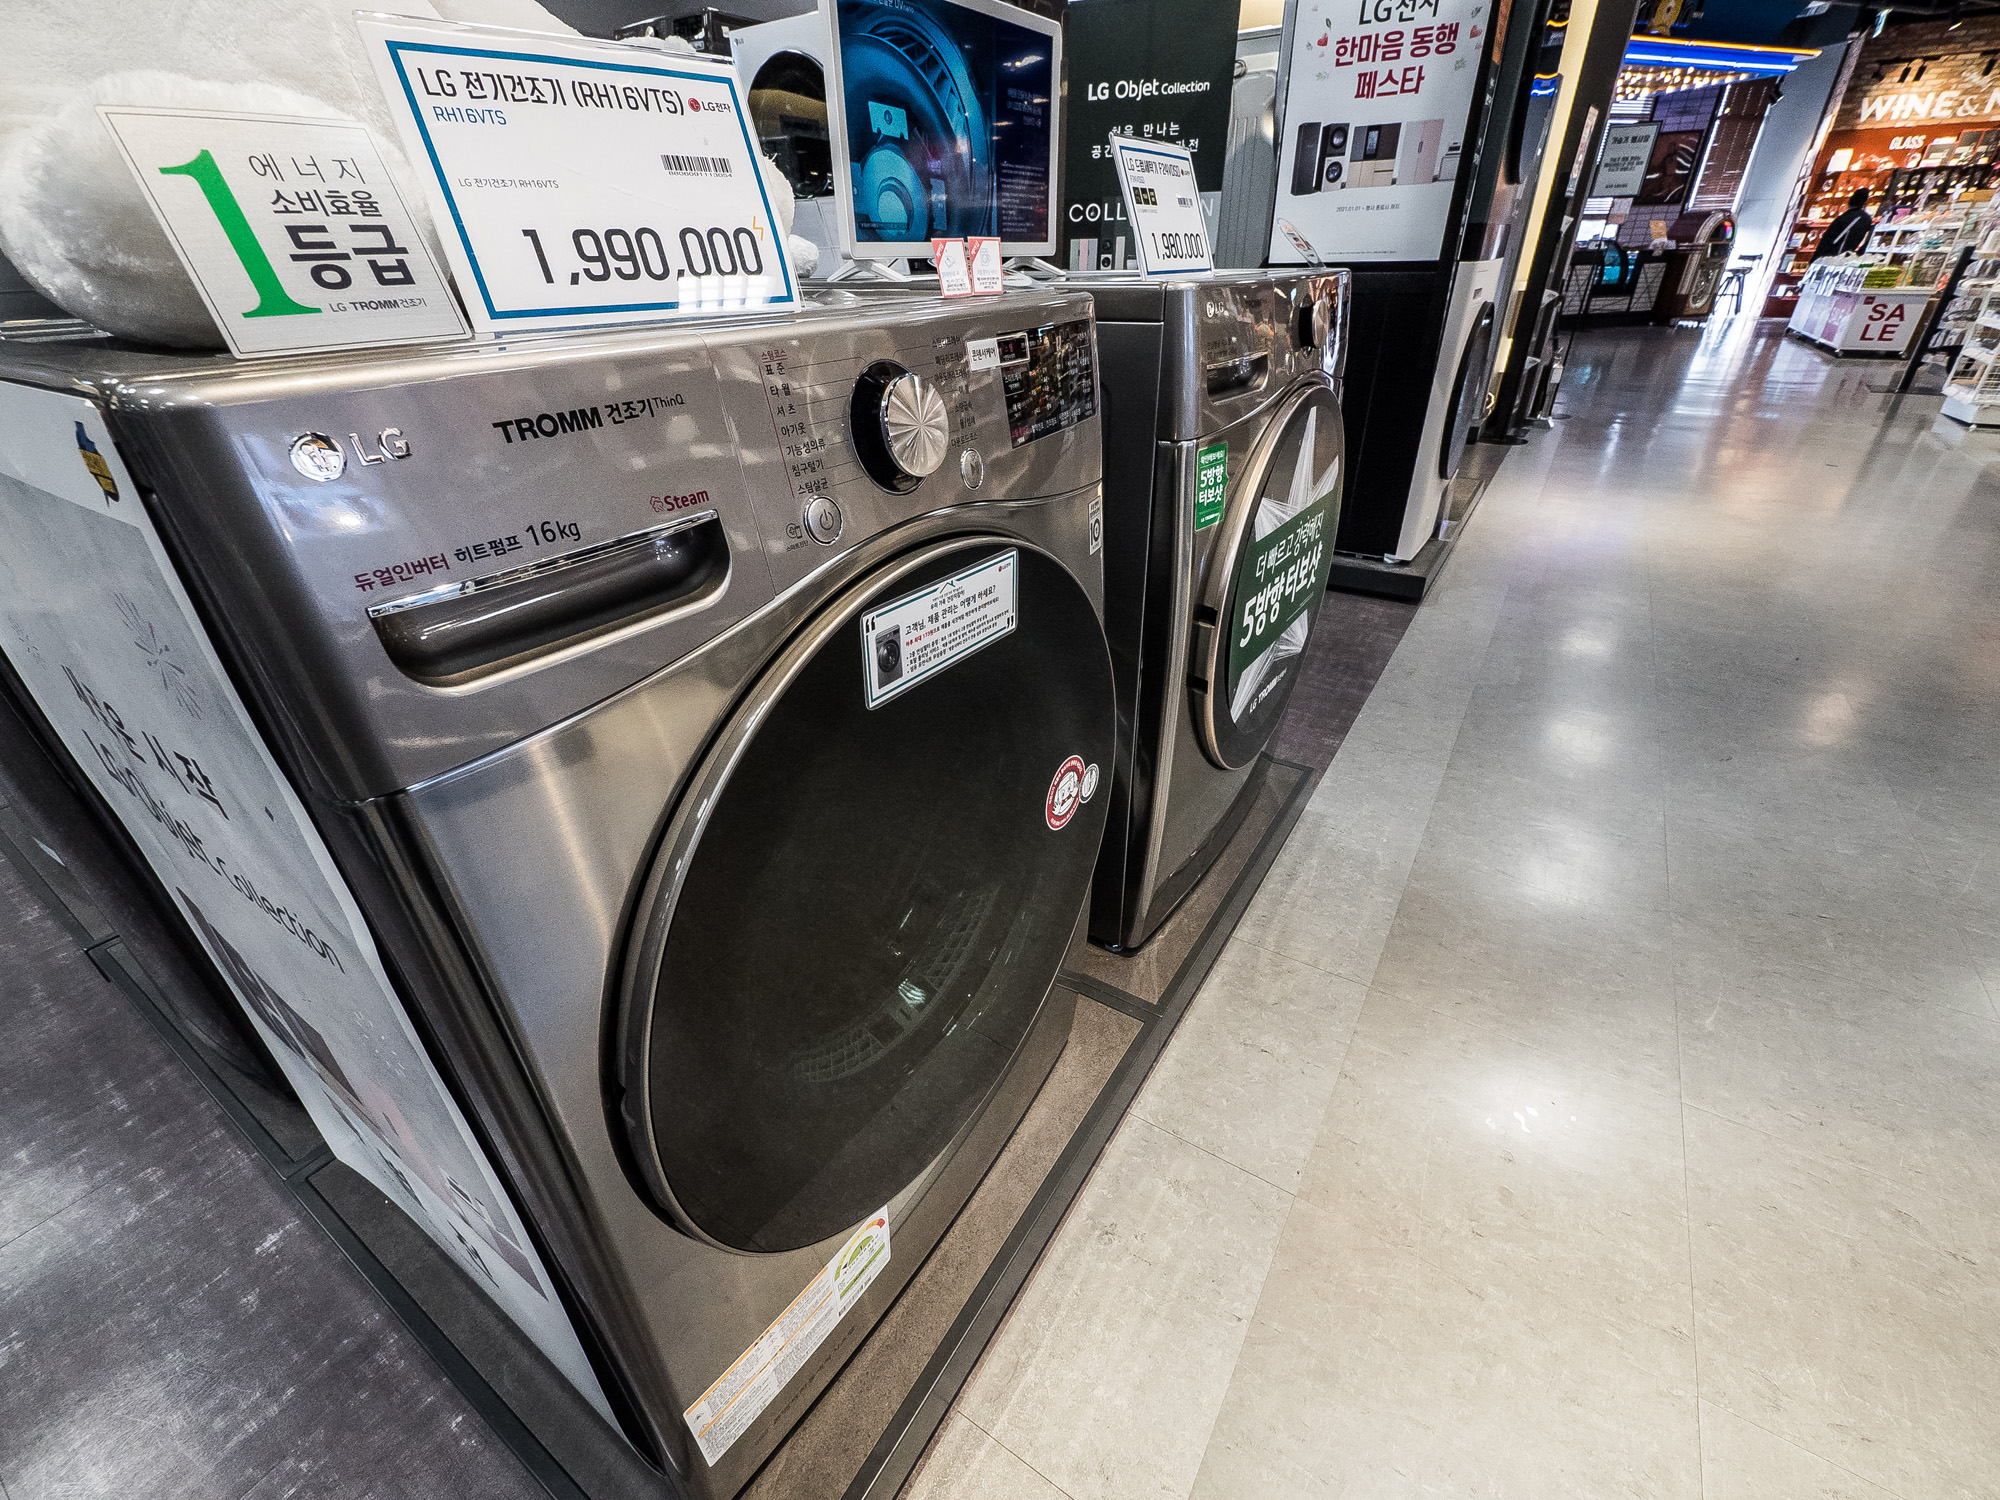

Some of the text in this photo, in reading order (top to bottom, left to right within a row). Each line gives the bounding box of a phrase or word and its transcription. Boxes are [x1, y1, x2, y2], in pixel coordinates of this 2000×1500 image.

[1335, 22, 1460, 67] 한마음 동행
[416, 67, 685, 116] LG 전기건조기 (RH16VTS)
[1088, 79, 1210, 100] LG Objet Collection
[1354, 66, 1425, 99] 페스타
[435, 105, 507, 126] RH16VTS
[1143, 122, 1179, 137] 만나는
[1889, 135, 1926, 150] GLASS
[248, 153, 366, 184] 에너지
[458, 178, 559, 190] LG 전기건조기 RH16VTS
[271, 189, 383, 217] 소비효율
[158, 149, 323, 318] 1
[1152, 233, 1204, 260] 1,980,000
[283, 224, 416, 290] 등급
[522, 227, 764, 286] 1,990,000
[329, 293, 347, 312] LG
[1868, 303, 1905, 322] SA
[1860, 324, 1900, 342] LE
[493, 407, 603, 443] TROMM
[605, 398, 655, 425] 건조기
[781, 422, 806, 437] 아기옷
[350, 427, 412, 466] LG
[786, 438, 827, 456] 기능성의류
[797, 478, 829, 495] 스팀살균
[1200, 464, 1224, 487] 5방향
[664, 488, 709, 511] Steam
[1199, 484, 1223, 506] 터보샷
[354, 520, 582, 592] 듀얼인버터 히트펌프 16kg
[1256, 551, 1267, 583] 더
[1267, 533, 1294, 575] 빠르고
[1240, 540, 1323, 648] 5방향 터보샷
[142, 731, 230, 821] 시작
